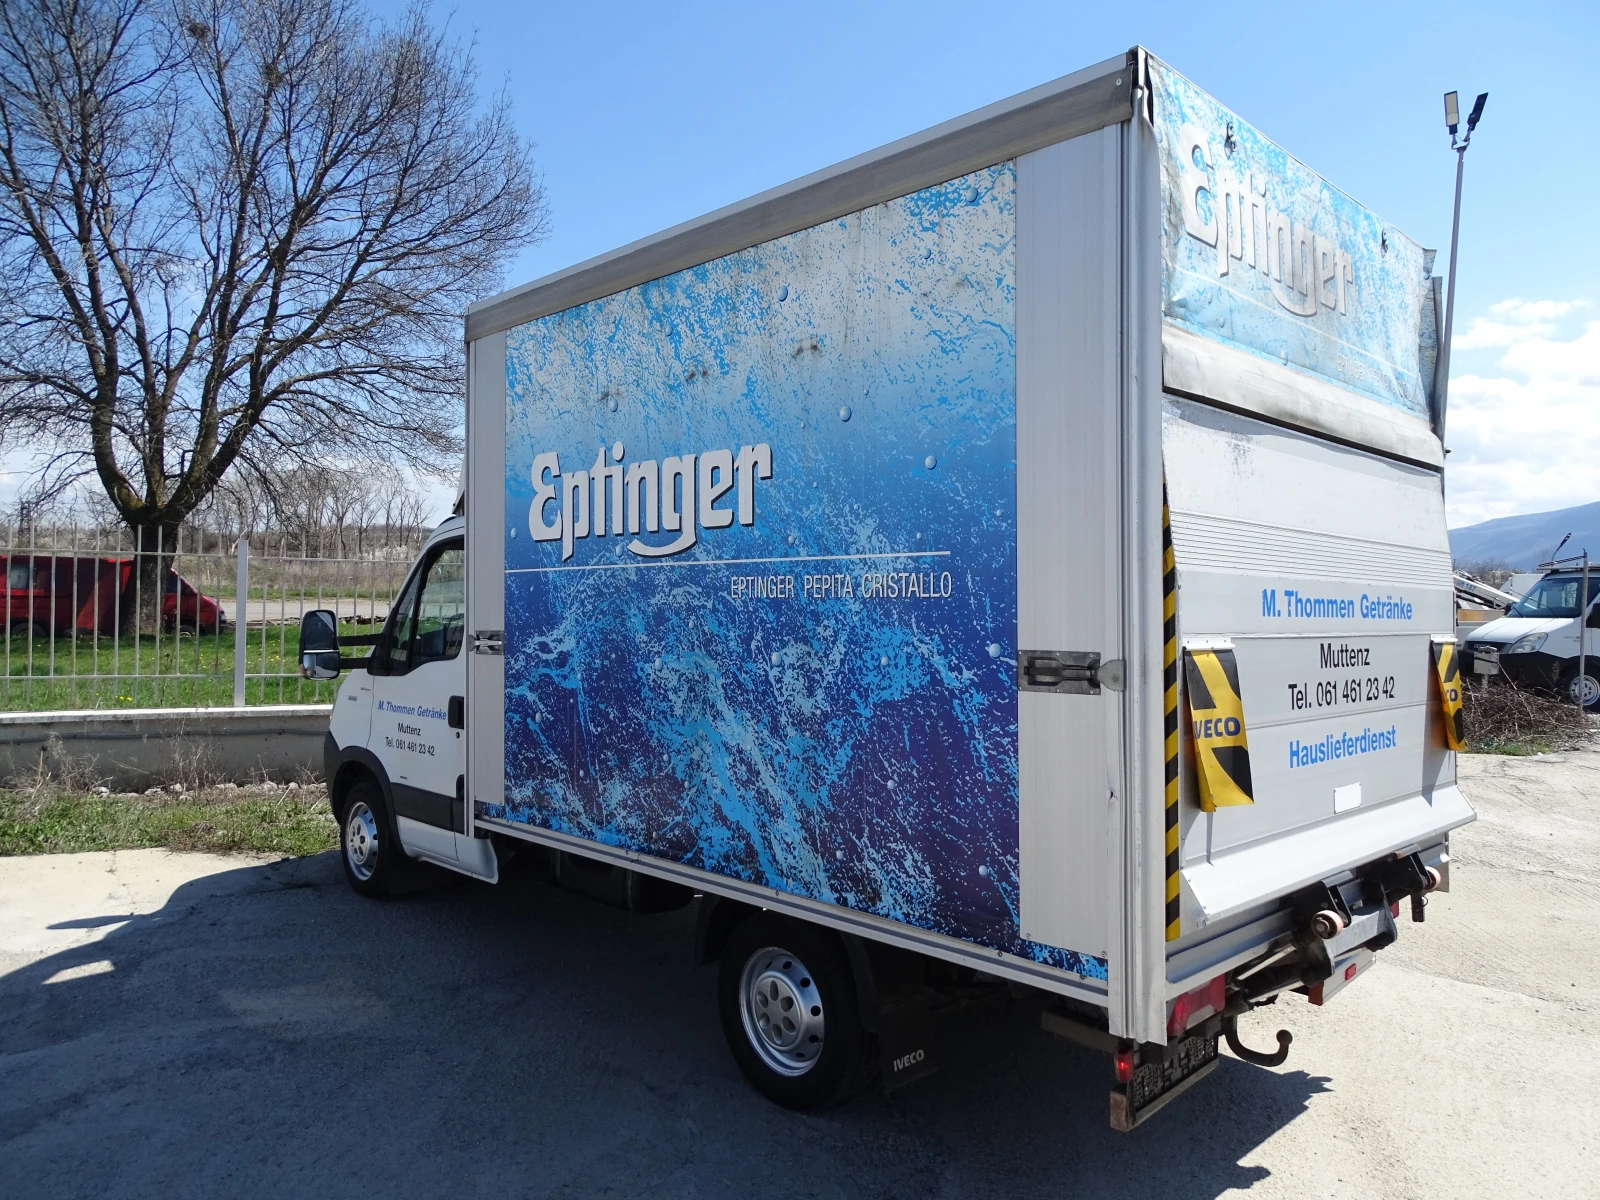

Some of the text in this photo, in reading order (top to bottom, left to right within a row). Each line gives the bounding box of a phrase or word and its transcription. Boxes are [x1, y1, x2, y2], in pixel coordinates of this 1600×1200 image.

[1178, 122, 1354, 318] Eptinger
[528, 441, 772, 561] Eptinger
[731, 571, 953, 598] EPTINGER PEPITA CRISTALLO
[1262, 589, 1413, 620] M. Thommen Getränke
[1320, 643, 1370, 668] Muttenz
[1288, 676, 1395, 710] Tel. 061 461 23 42
[378, 700, 447, 720] M. Thommen Getränke
[398, 722, 421, 736] Muttenz
[1194, 717, 1241, 739] VECO
[385, 736, 435, 756] Tel. 061 461 23 42
[1289, 725, 1396, 768] Hauslieferdienst
[893, 1049, 925, 1072] IVECO
